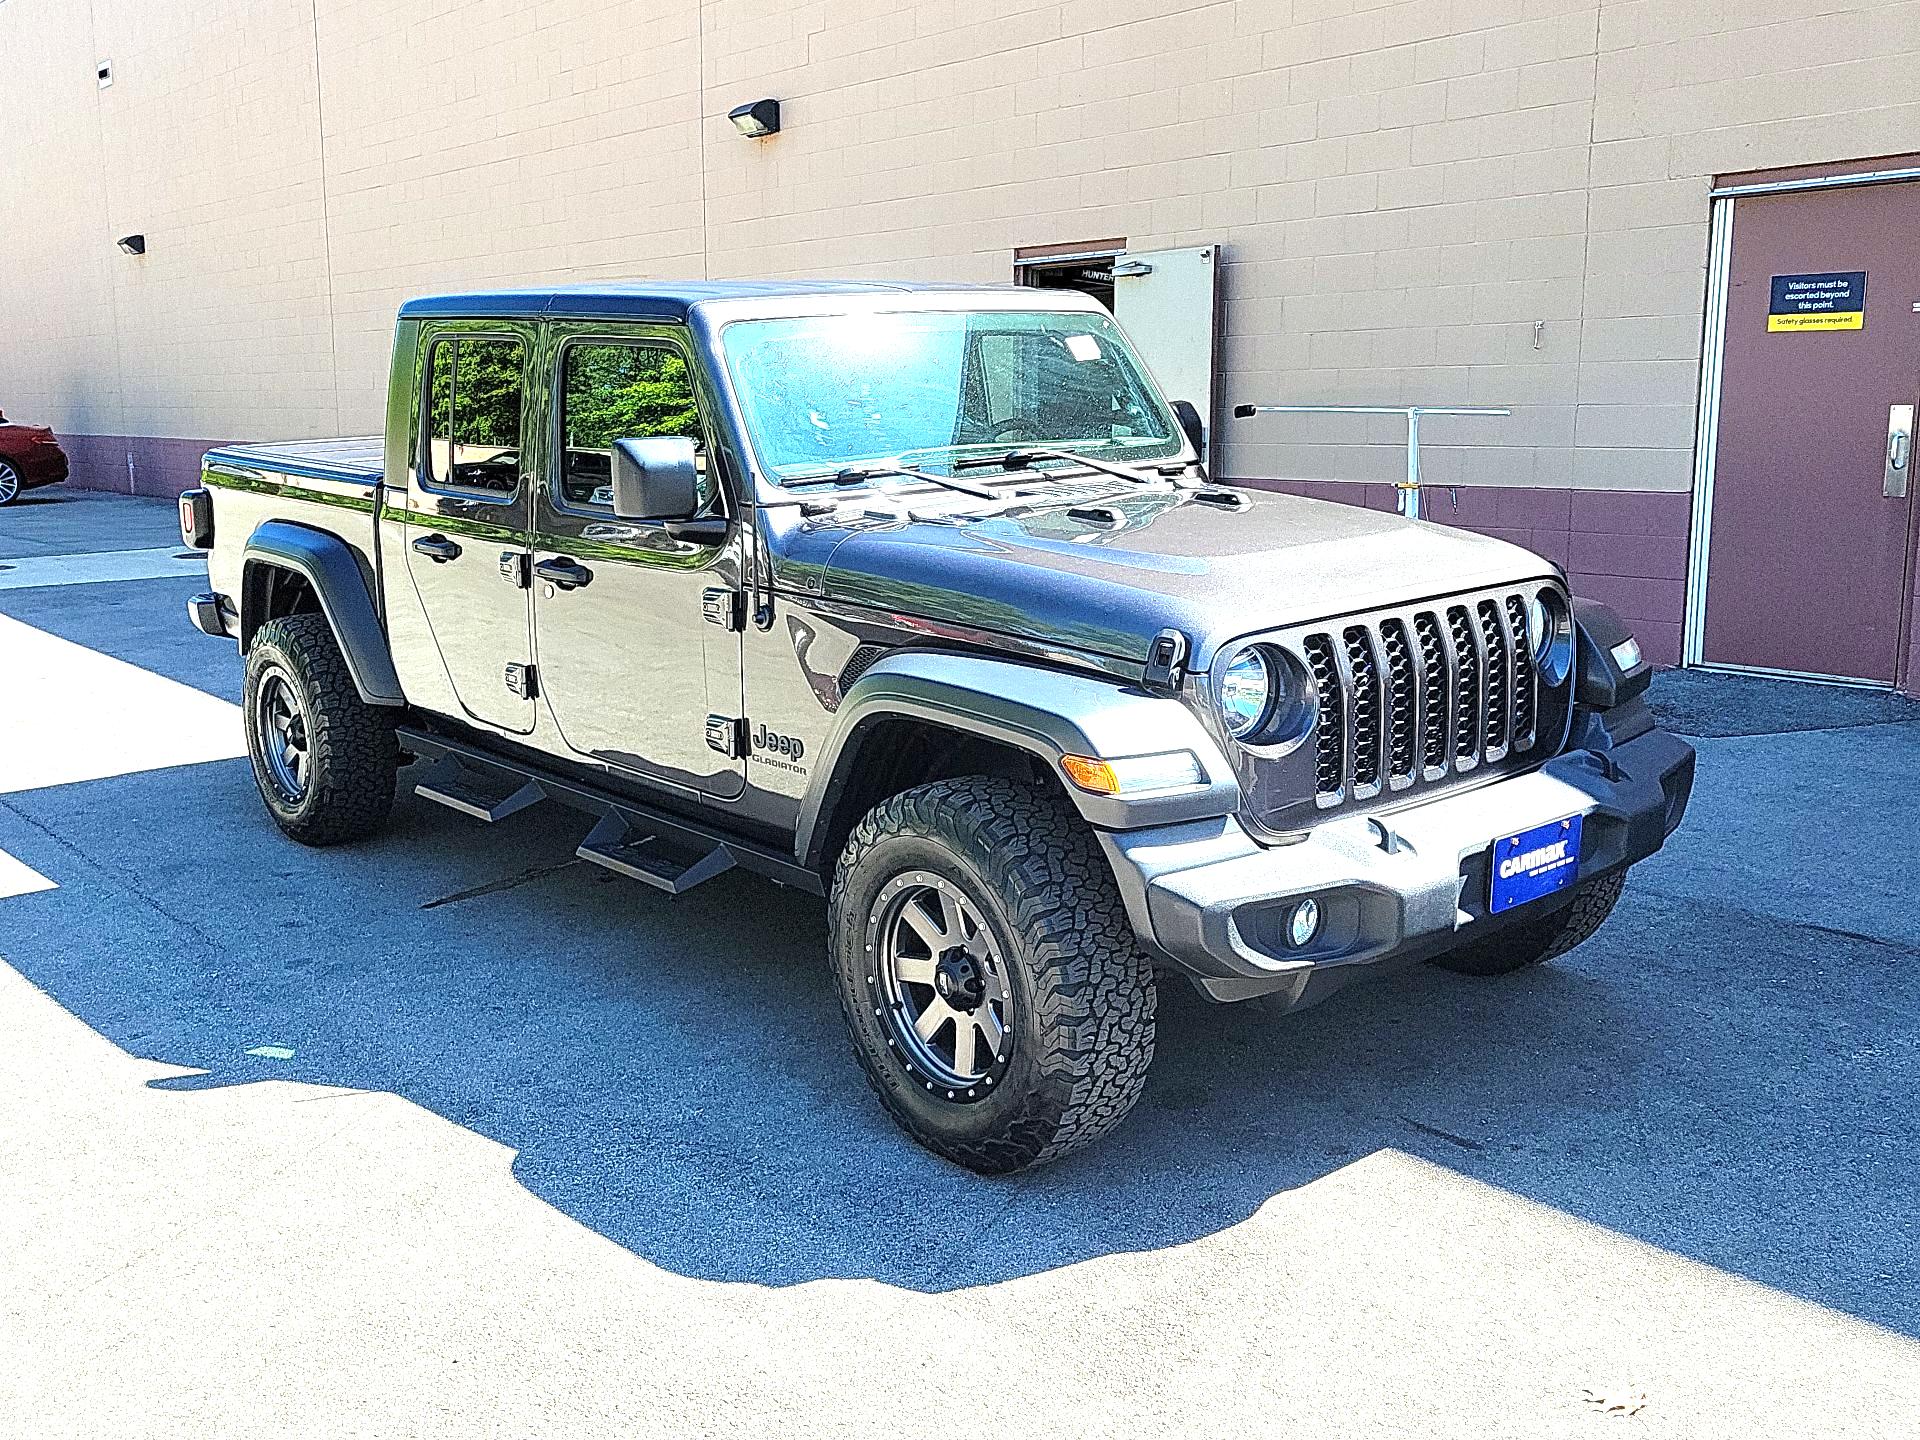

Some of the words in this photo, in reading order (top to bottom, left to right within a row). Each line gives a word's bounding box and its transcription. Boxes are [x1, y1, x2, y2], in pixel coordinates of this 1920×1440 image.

[1081, 269, 1114, 282] HUNTER
[1788, 282, 1816, 290] Visitors
[1817, 281, 1837, 289] must
[1837, 280, 1849, 288] be
[1785, 291, 1819, 300] escorted
[1820, 290, 1850, 300] beyond
[1798, 301, 1812, 310] this
[1812, 301, 1835, 311] point.
[1777, 317, 1799, 326] Safety
[1799, 316, 1824, 326] glasses
[753, 724, 804, 762] Jeep
[752, 754, 807, 776] GLADIATOR
